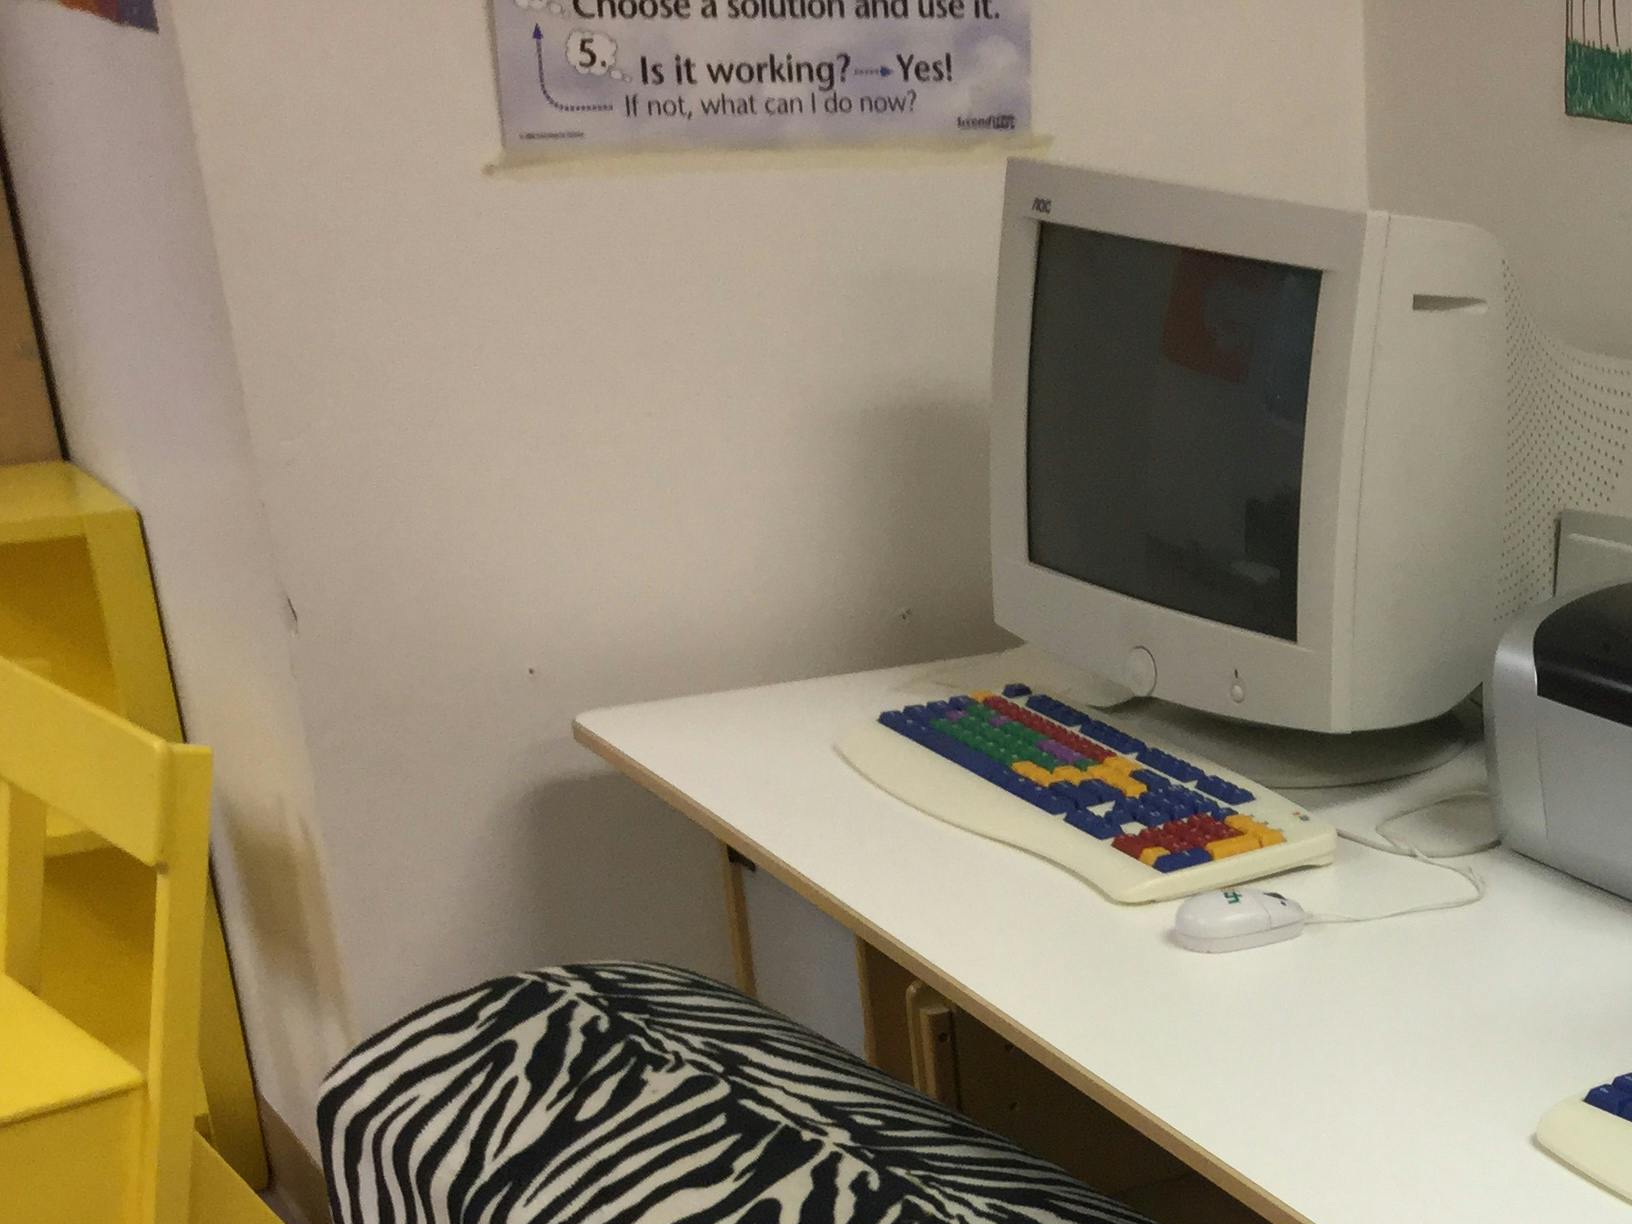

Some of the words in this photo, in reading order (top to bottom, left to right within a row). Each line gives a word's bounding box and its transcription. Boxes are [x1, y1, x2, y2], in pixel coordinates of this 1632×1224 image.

[572, 0, 691, 20] Choose
[701, 0, 718, 20] a
[727, 0, 845, 20] solution
[854, 0, 909, 20] and
[918, 0, 965, 20] use
[973, 0, 1000, 20] it.
[578, 38, 607, 68] 5.
[640, 55, 665, 85] Is
[675, 54, 698, 85] it
[706, 54, 851, 92] working?
[896, 53, 953, 83] Yes!
[624, 94, 639, 117] If
[647, 95, 693, 120] not,
[700, 93, 758, 116] what
[764, 95, 803, 116] can
[810, 92, 816, 114] I
[823, 92, 852, 115] do
[859, 89, 917, 113] now?
